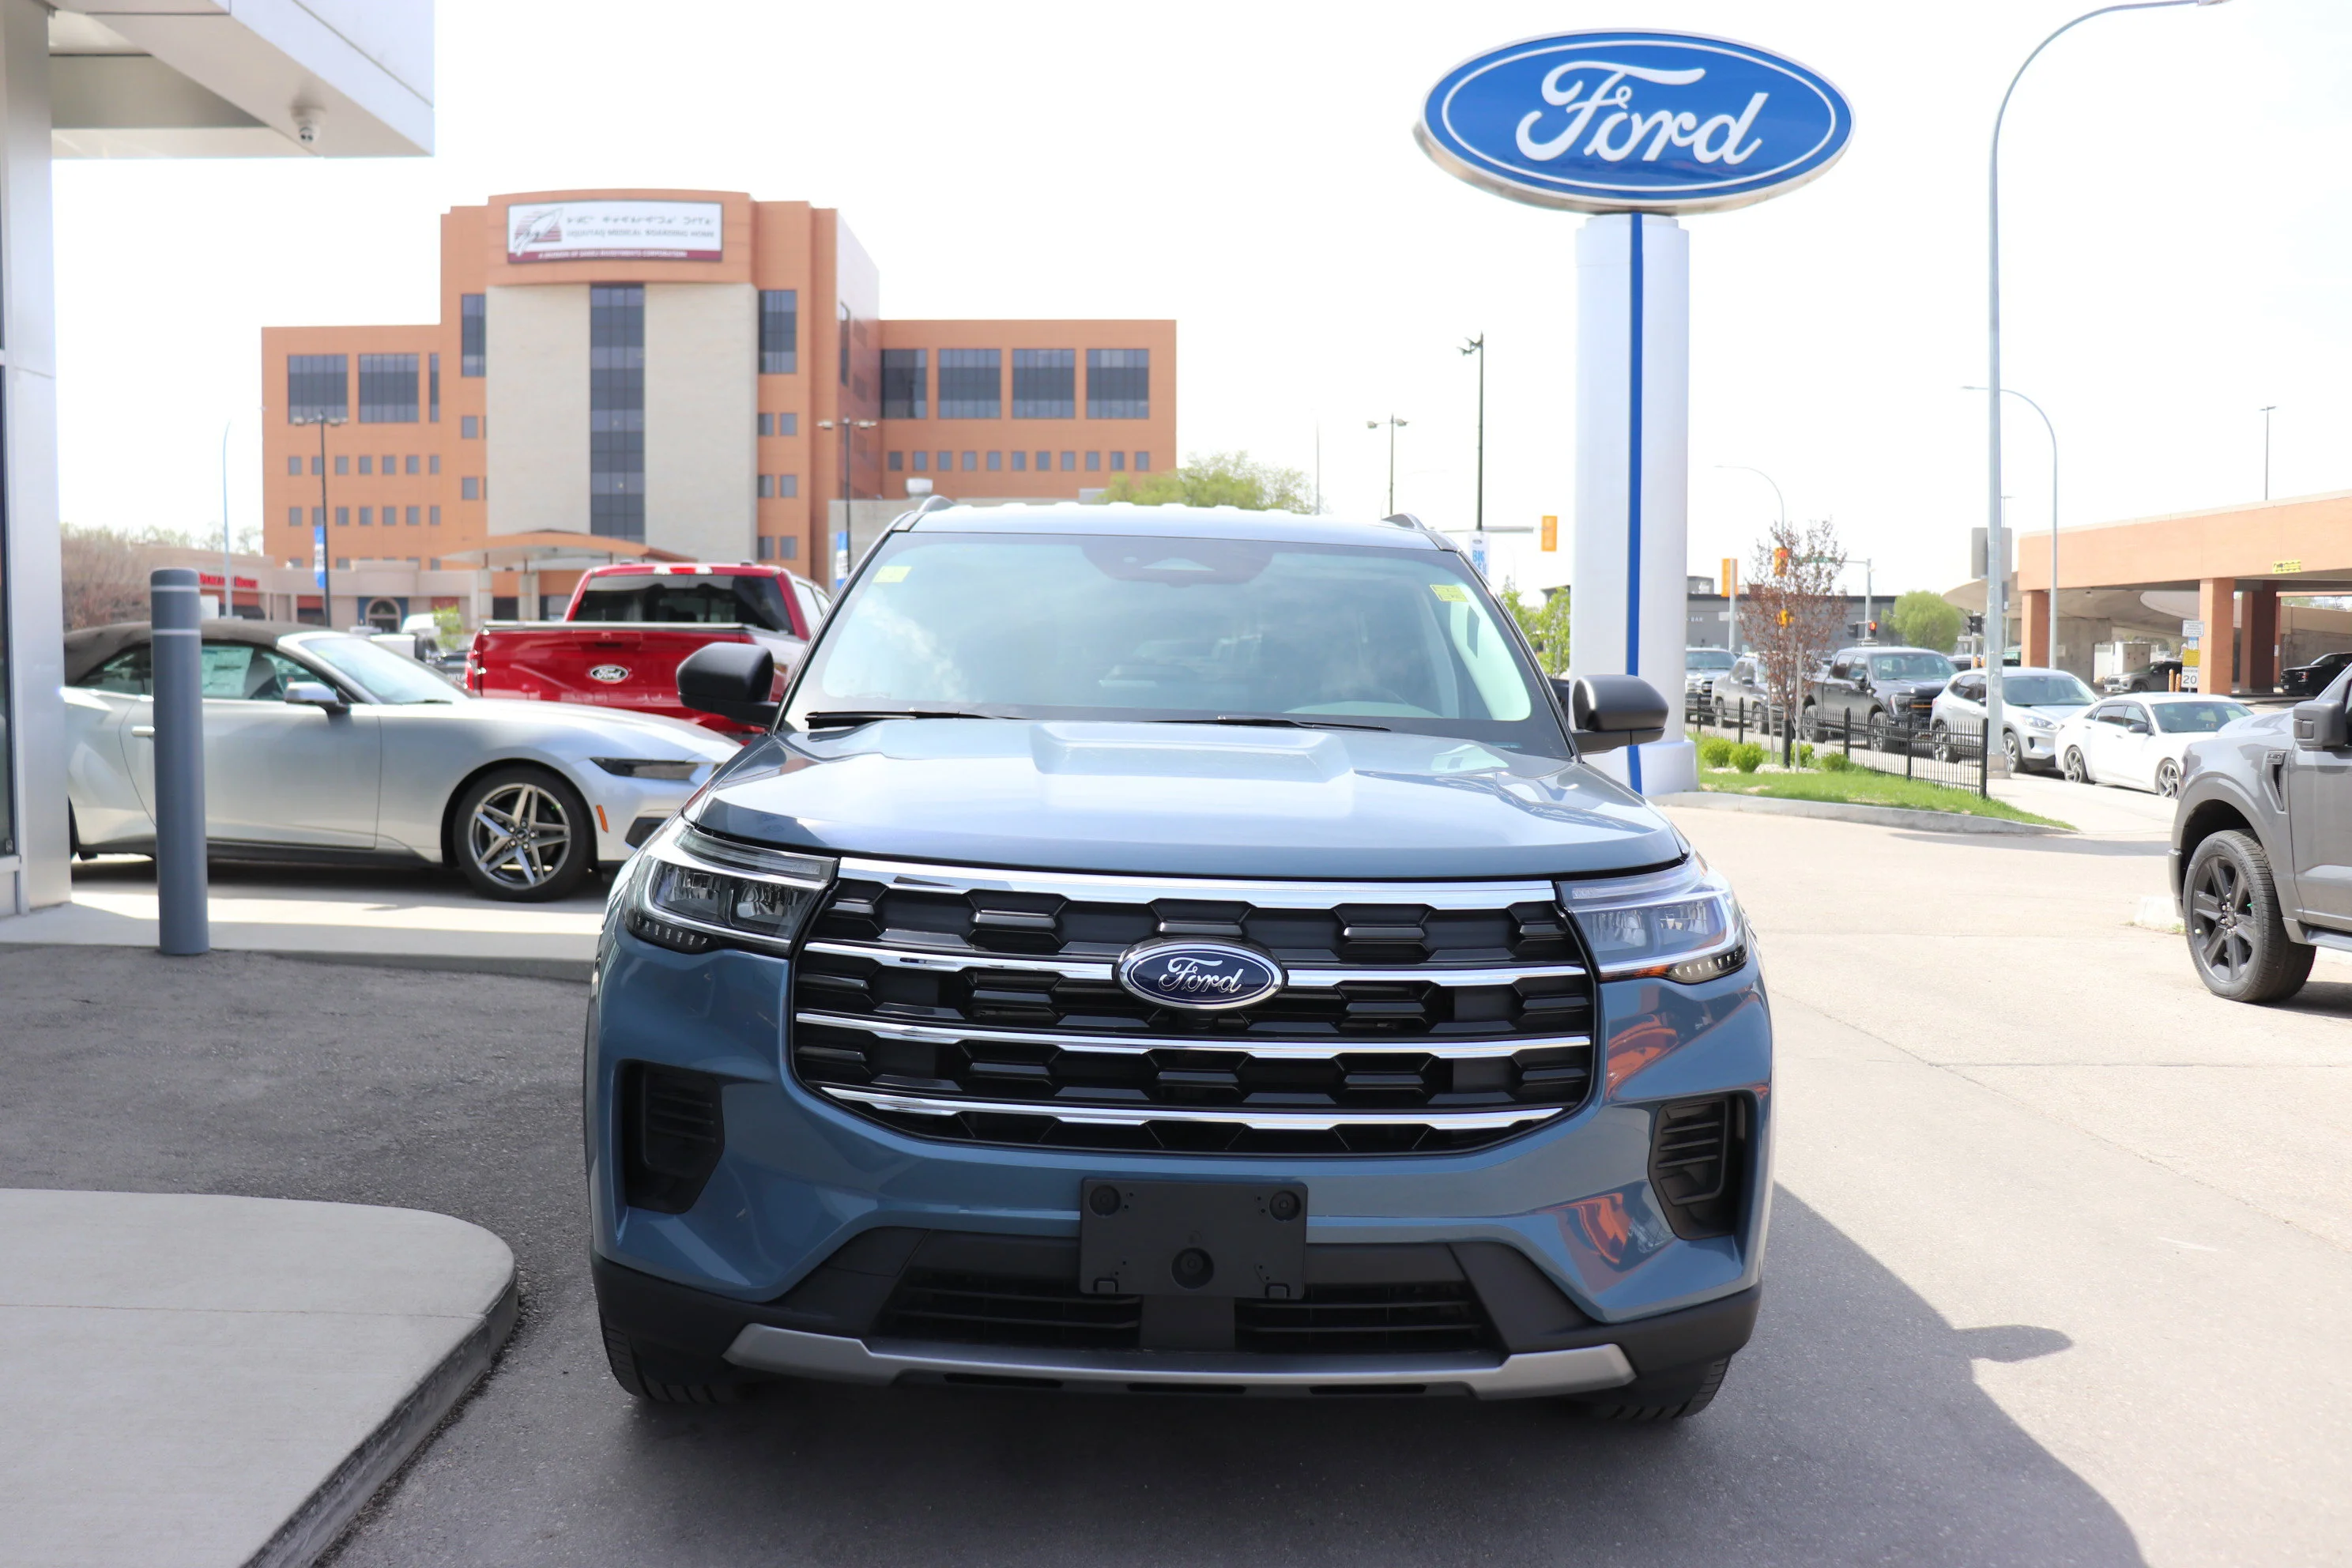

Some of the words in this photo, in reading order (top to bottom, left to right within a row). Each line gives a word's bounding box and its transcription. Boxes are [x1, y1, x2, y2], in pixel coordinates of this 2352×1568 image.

[1515, 60, 1770, 165] Ford
[597, 666, 622, 679] Ford
[2183, 675, 2197, 684] 20
[1158, 956, 1244, 993] Ford
